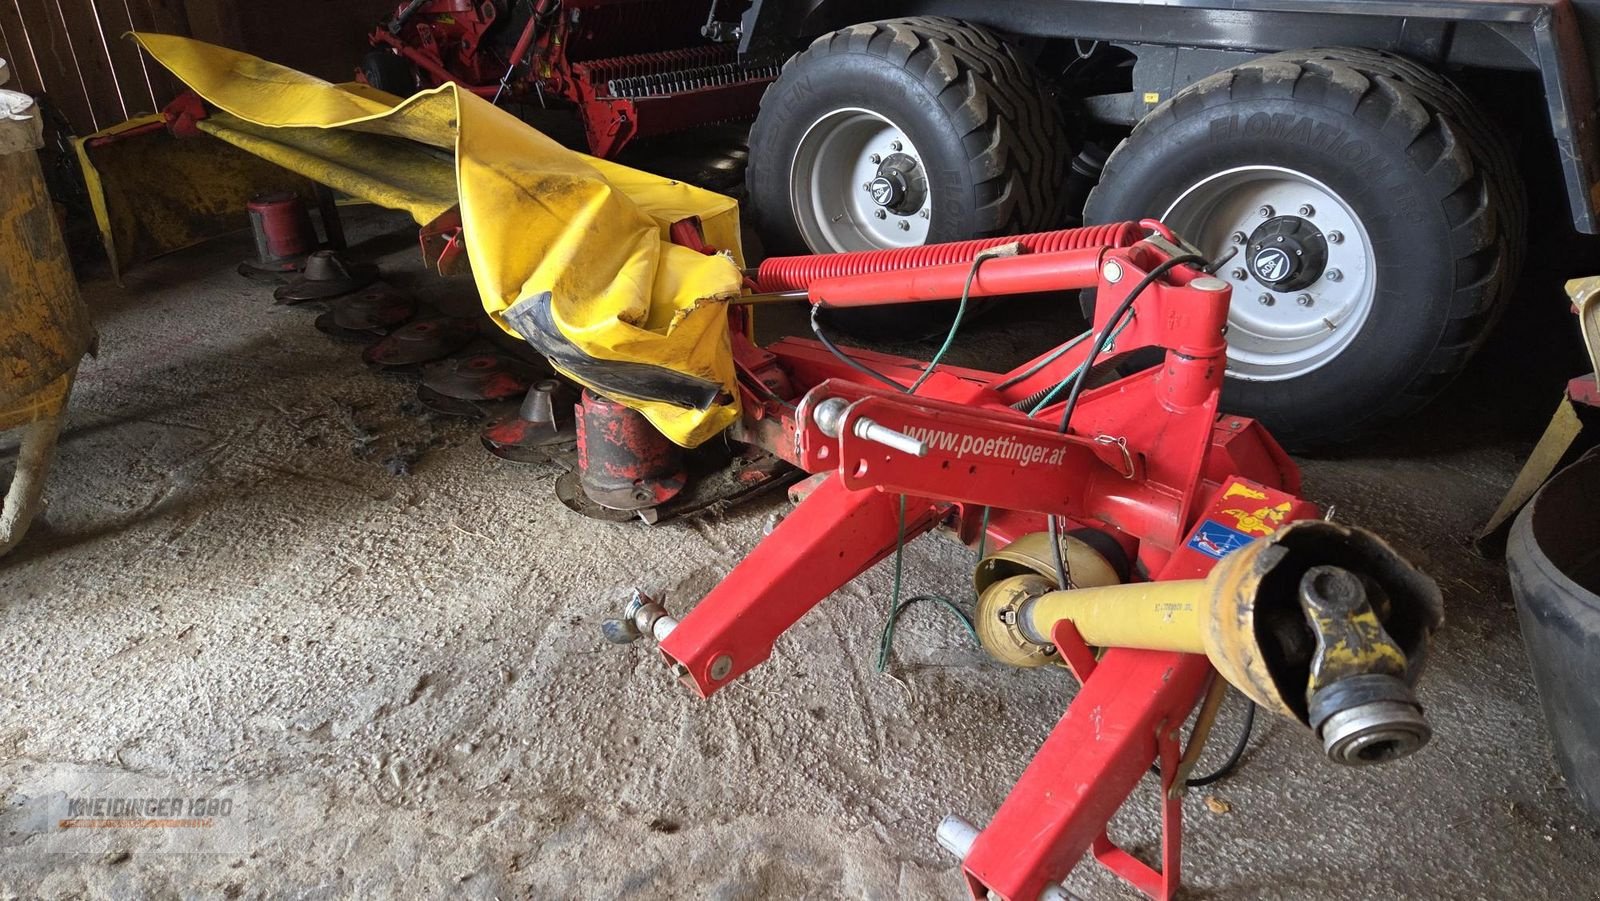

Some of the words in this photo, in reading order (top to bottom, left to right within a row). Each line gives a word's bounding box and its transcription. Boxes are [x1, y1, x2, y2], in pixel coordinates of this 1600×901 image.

[1208, 111, 1393, 184] FLOTATION
[1260, 260, 1277, 277] ADR
[902, 424, 1067, 466] www.poettinger.at
